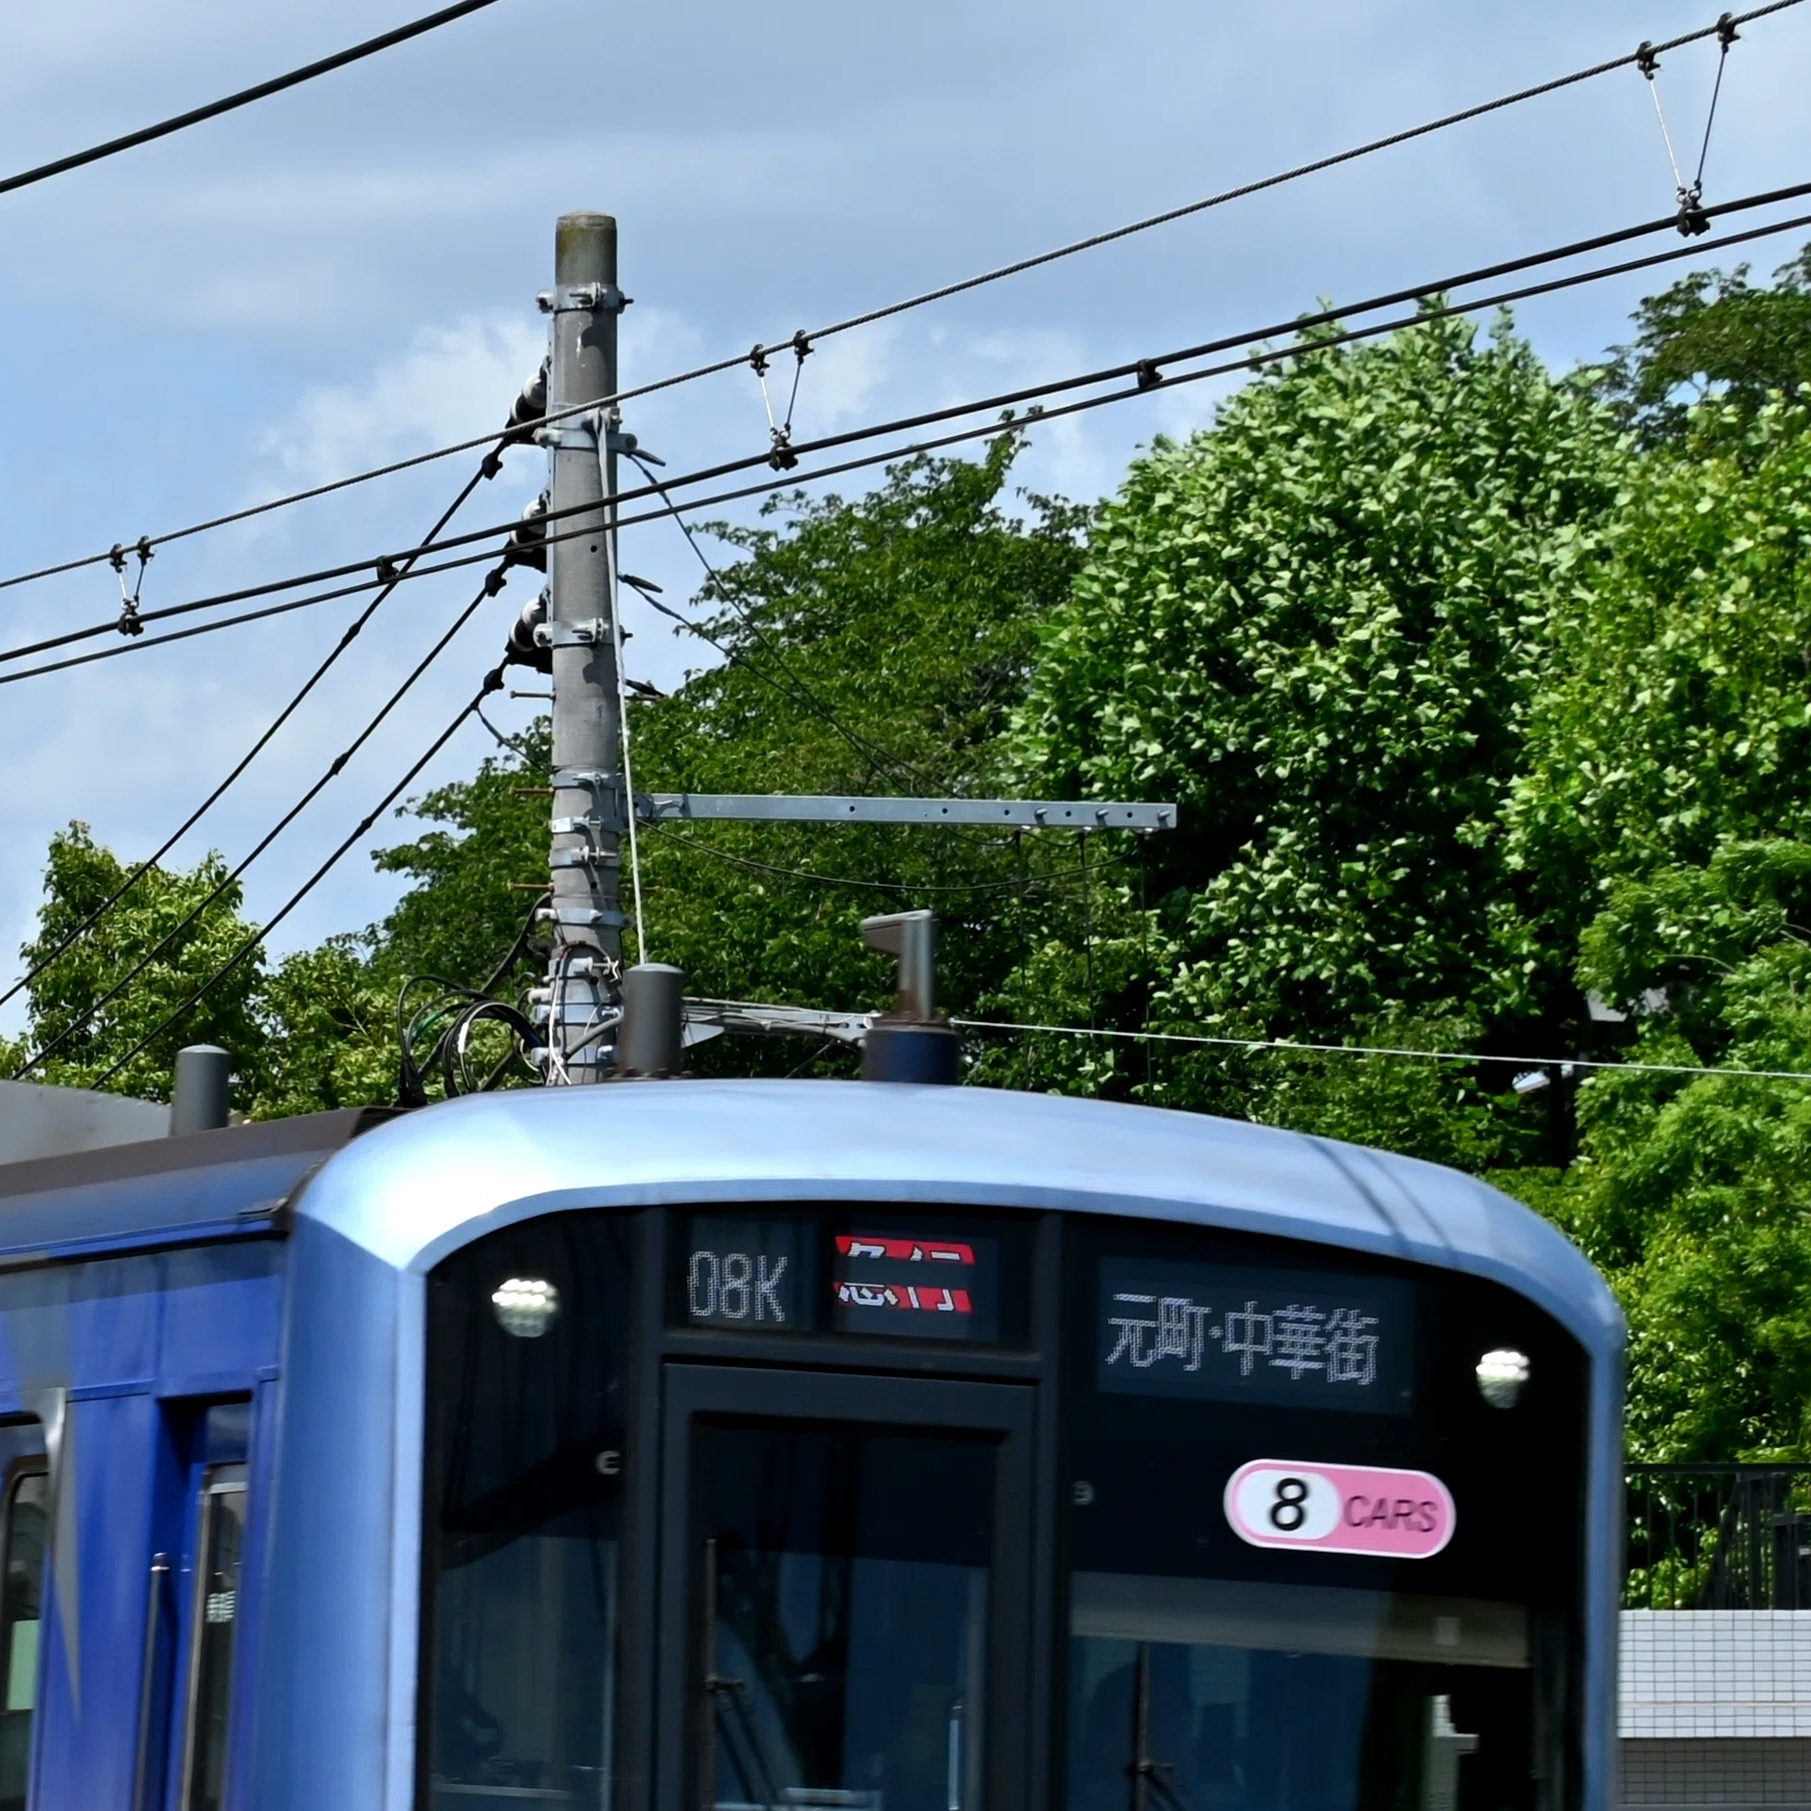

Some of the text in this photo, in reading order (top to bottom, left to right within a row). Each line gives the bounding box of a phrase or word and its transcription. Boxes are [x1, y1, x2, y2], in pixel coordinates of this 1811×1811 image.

[686, 1250, 788, 1322] 08K
[1268, 1477, 1440, 1534] 8 CARS
